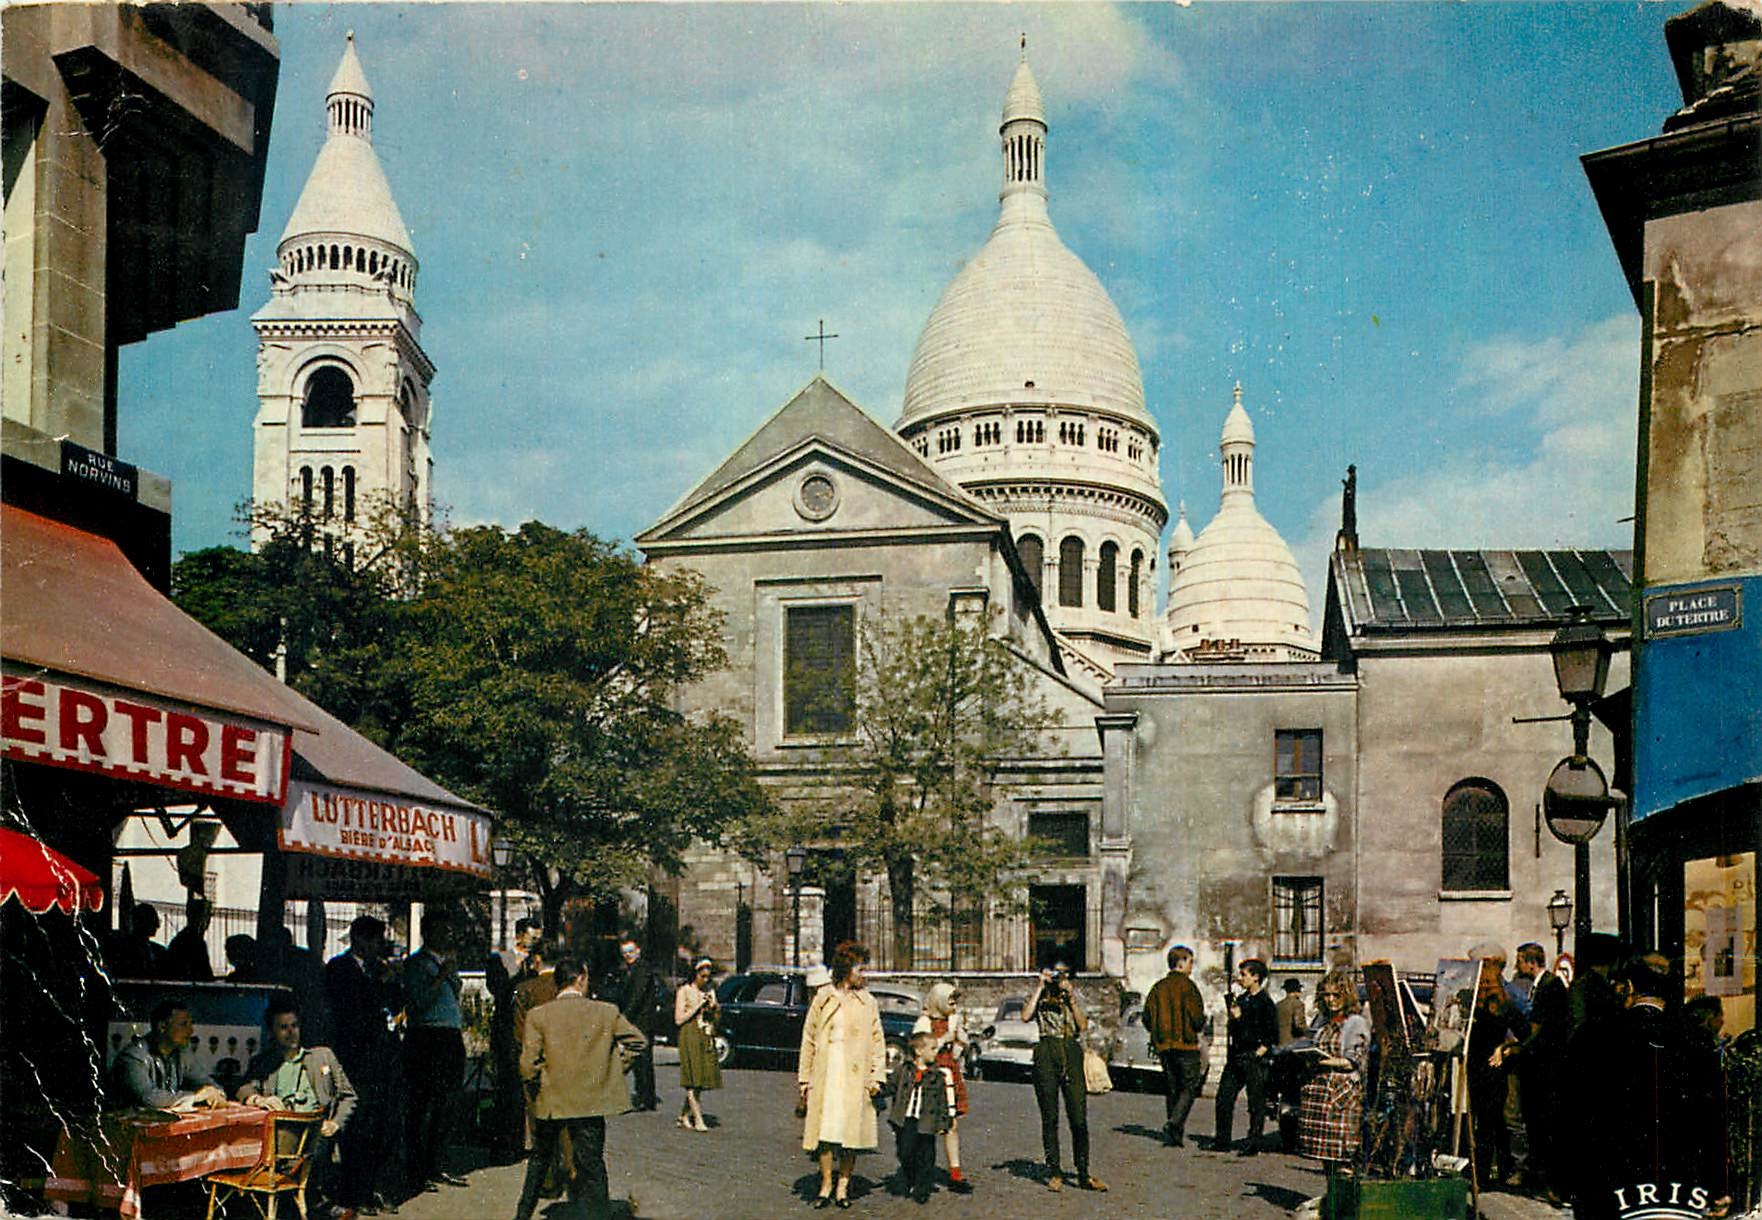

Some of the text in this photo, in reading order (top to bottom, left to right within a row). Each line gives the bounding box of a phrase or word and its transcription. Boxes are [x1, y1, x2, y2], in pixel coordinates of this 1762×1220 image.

[88, 453, 114, 472] RUE
[68, 459, 131, 493] NORVINS
[1669, 596, 1717, 612] PLACE
[1657, 609, 1729, 628] DU TERTRE
[311, 791, 456, 842] LUTTERBACH
